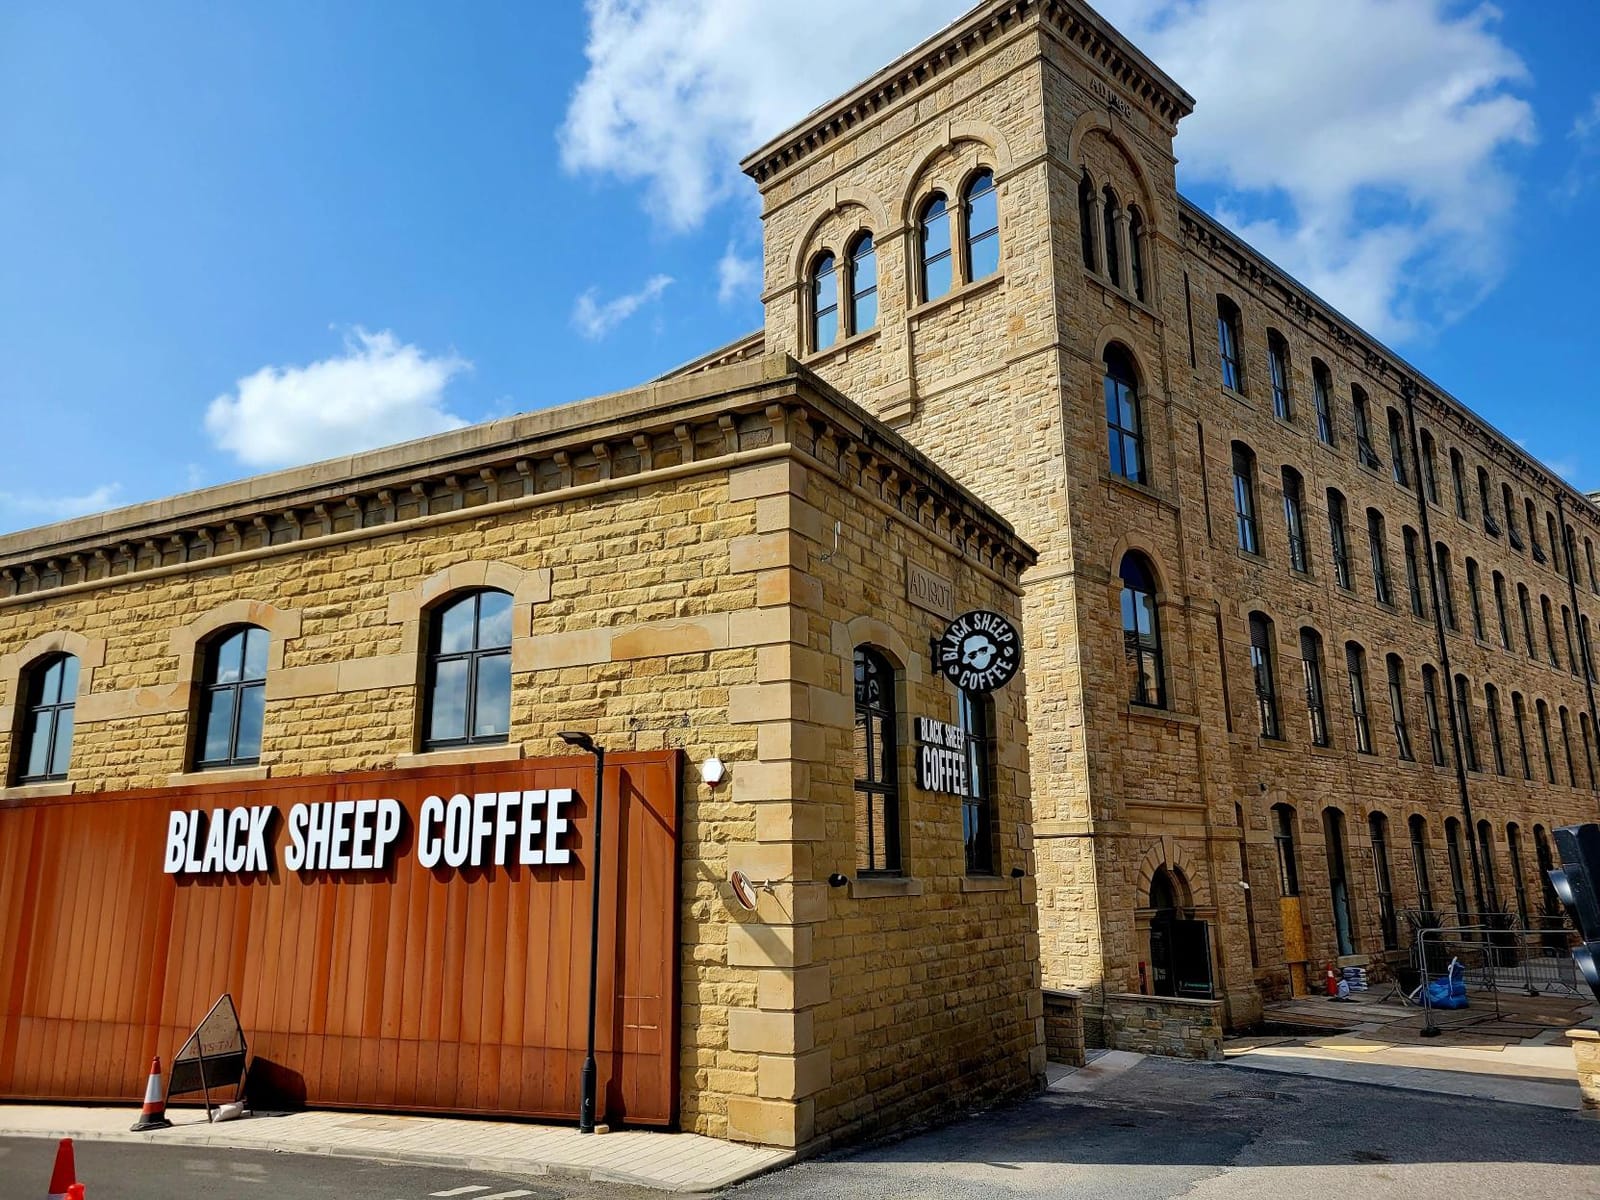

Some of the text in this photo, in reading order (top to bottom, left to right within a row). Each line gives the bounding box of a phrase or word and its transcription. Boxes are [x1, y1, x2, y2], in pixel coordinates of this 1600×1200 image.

[942, 613, 1013, 661] BLACK SHEEP
[959, 658, 1013, 690] COFFEE
[920, 716, 965, 750] BLACK SHEEP
[922, 745, 969, 796] COFFEE
[163, 788, 573, 873] BLACK SHEEP COFFEE
